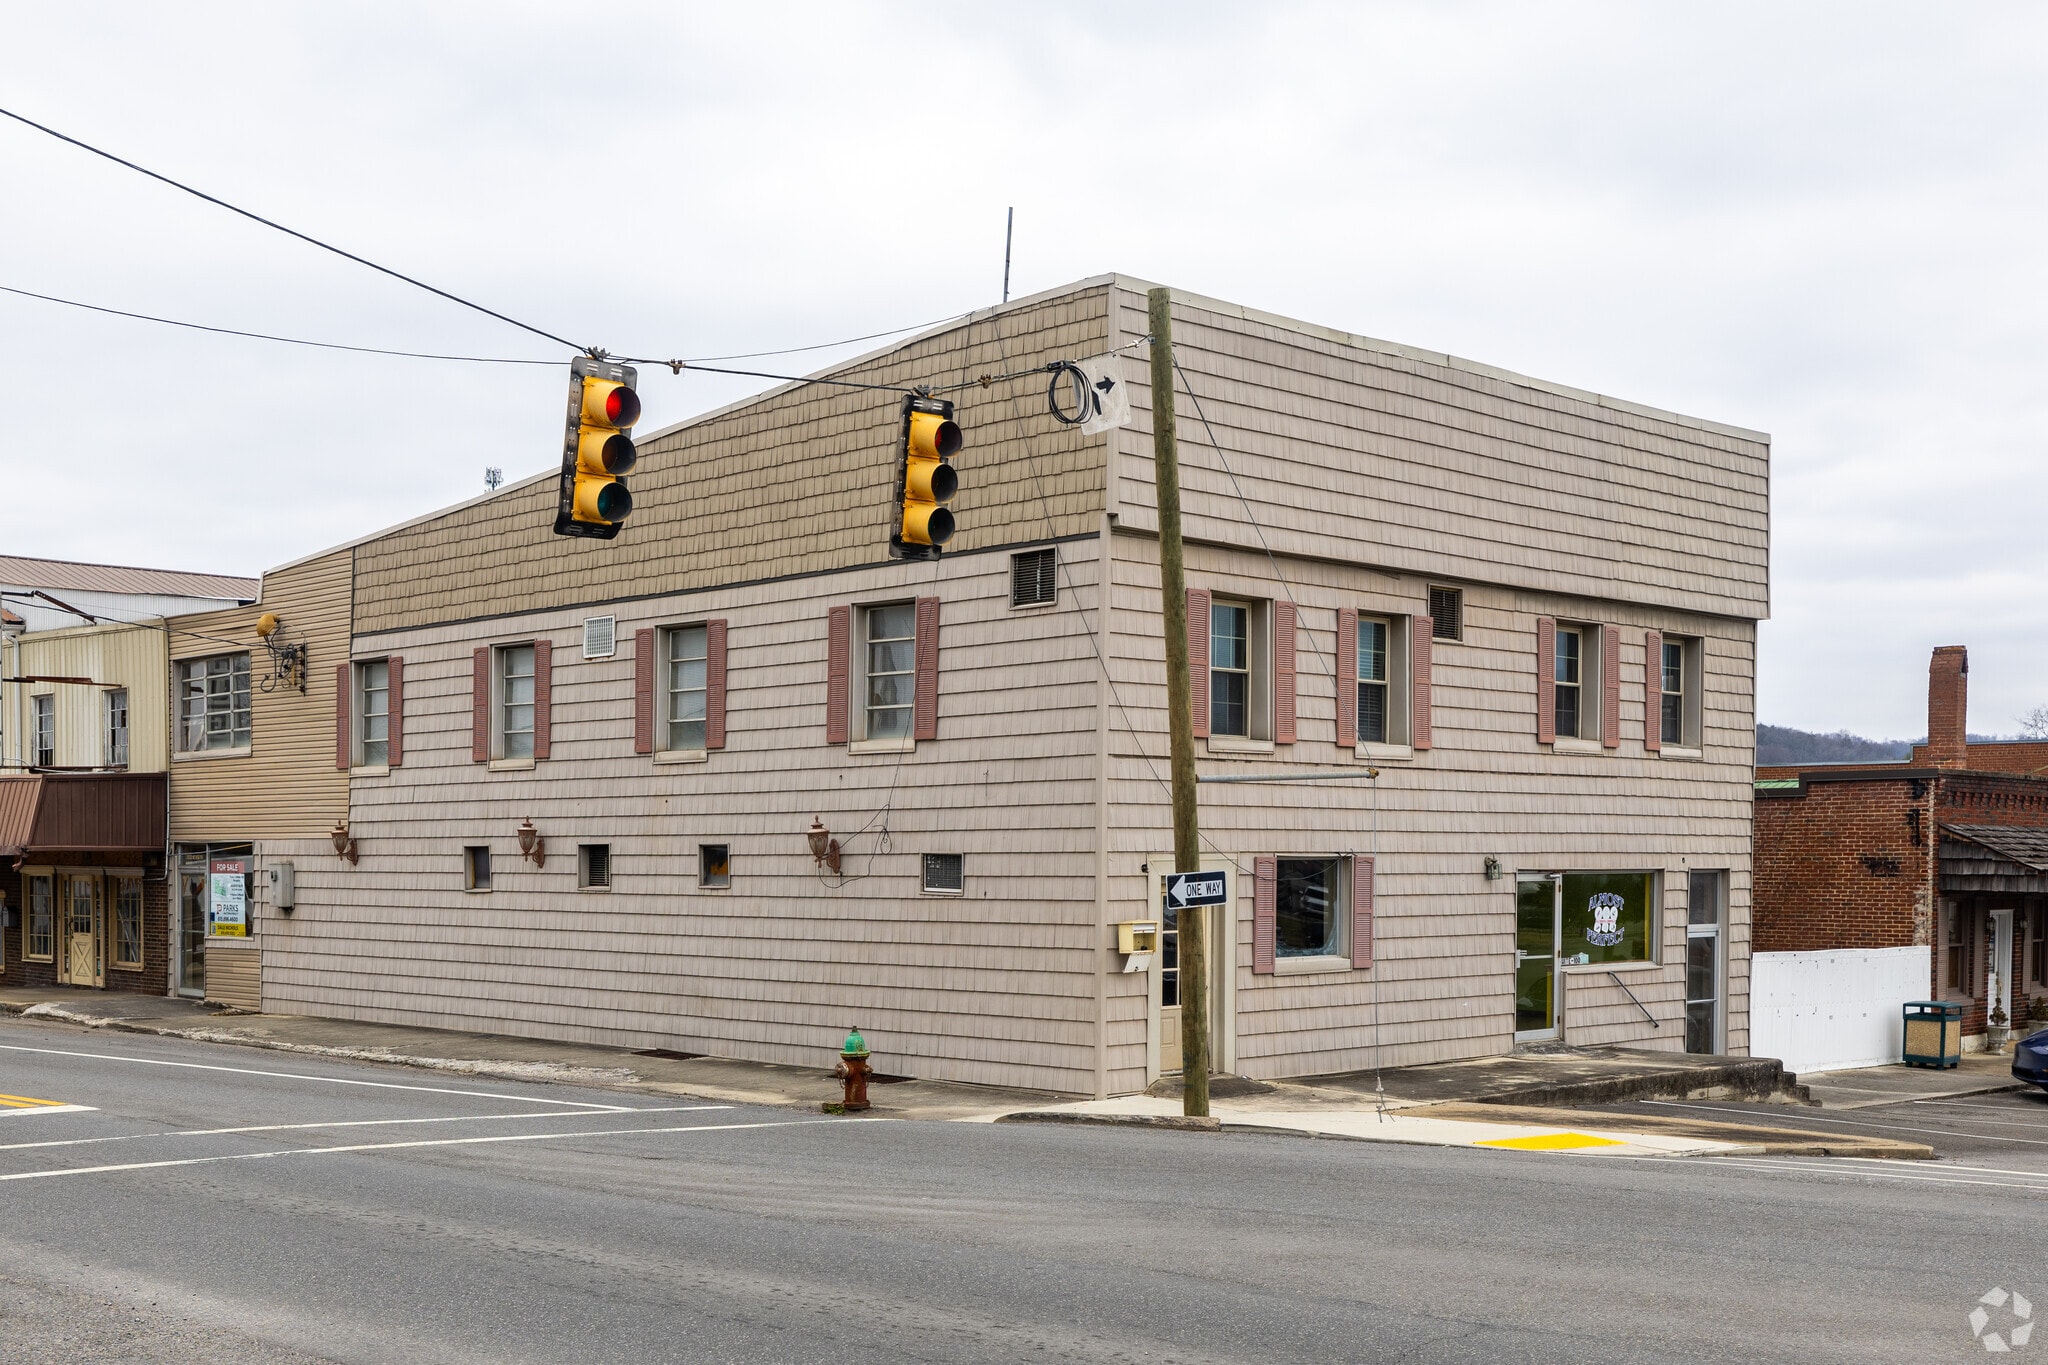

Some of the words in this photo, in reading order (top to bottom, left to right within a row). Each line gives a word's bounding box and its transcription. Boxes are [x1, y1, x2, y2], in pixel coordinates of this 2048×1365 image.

[1187, 884, 1202, 896] ONE
[1206, 882, 1220, 895] WAY
[1588, 893, 1624, 912] ALMOST
[1587, 927, 1624, 946] PERFECT
